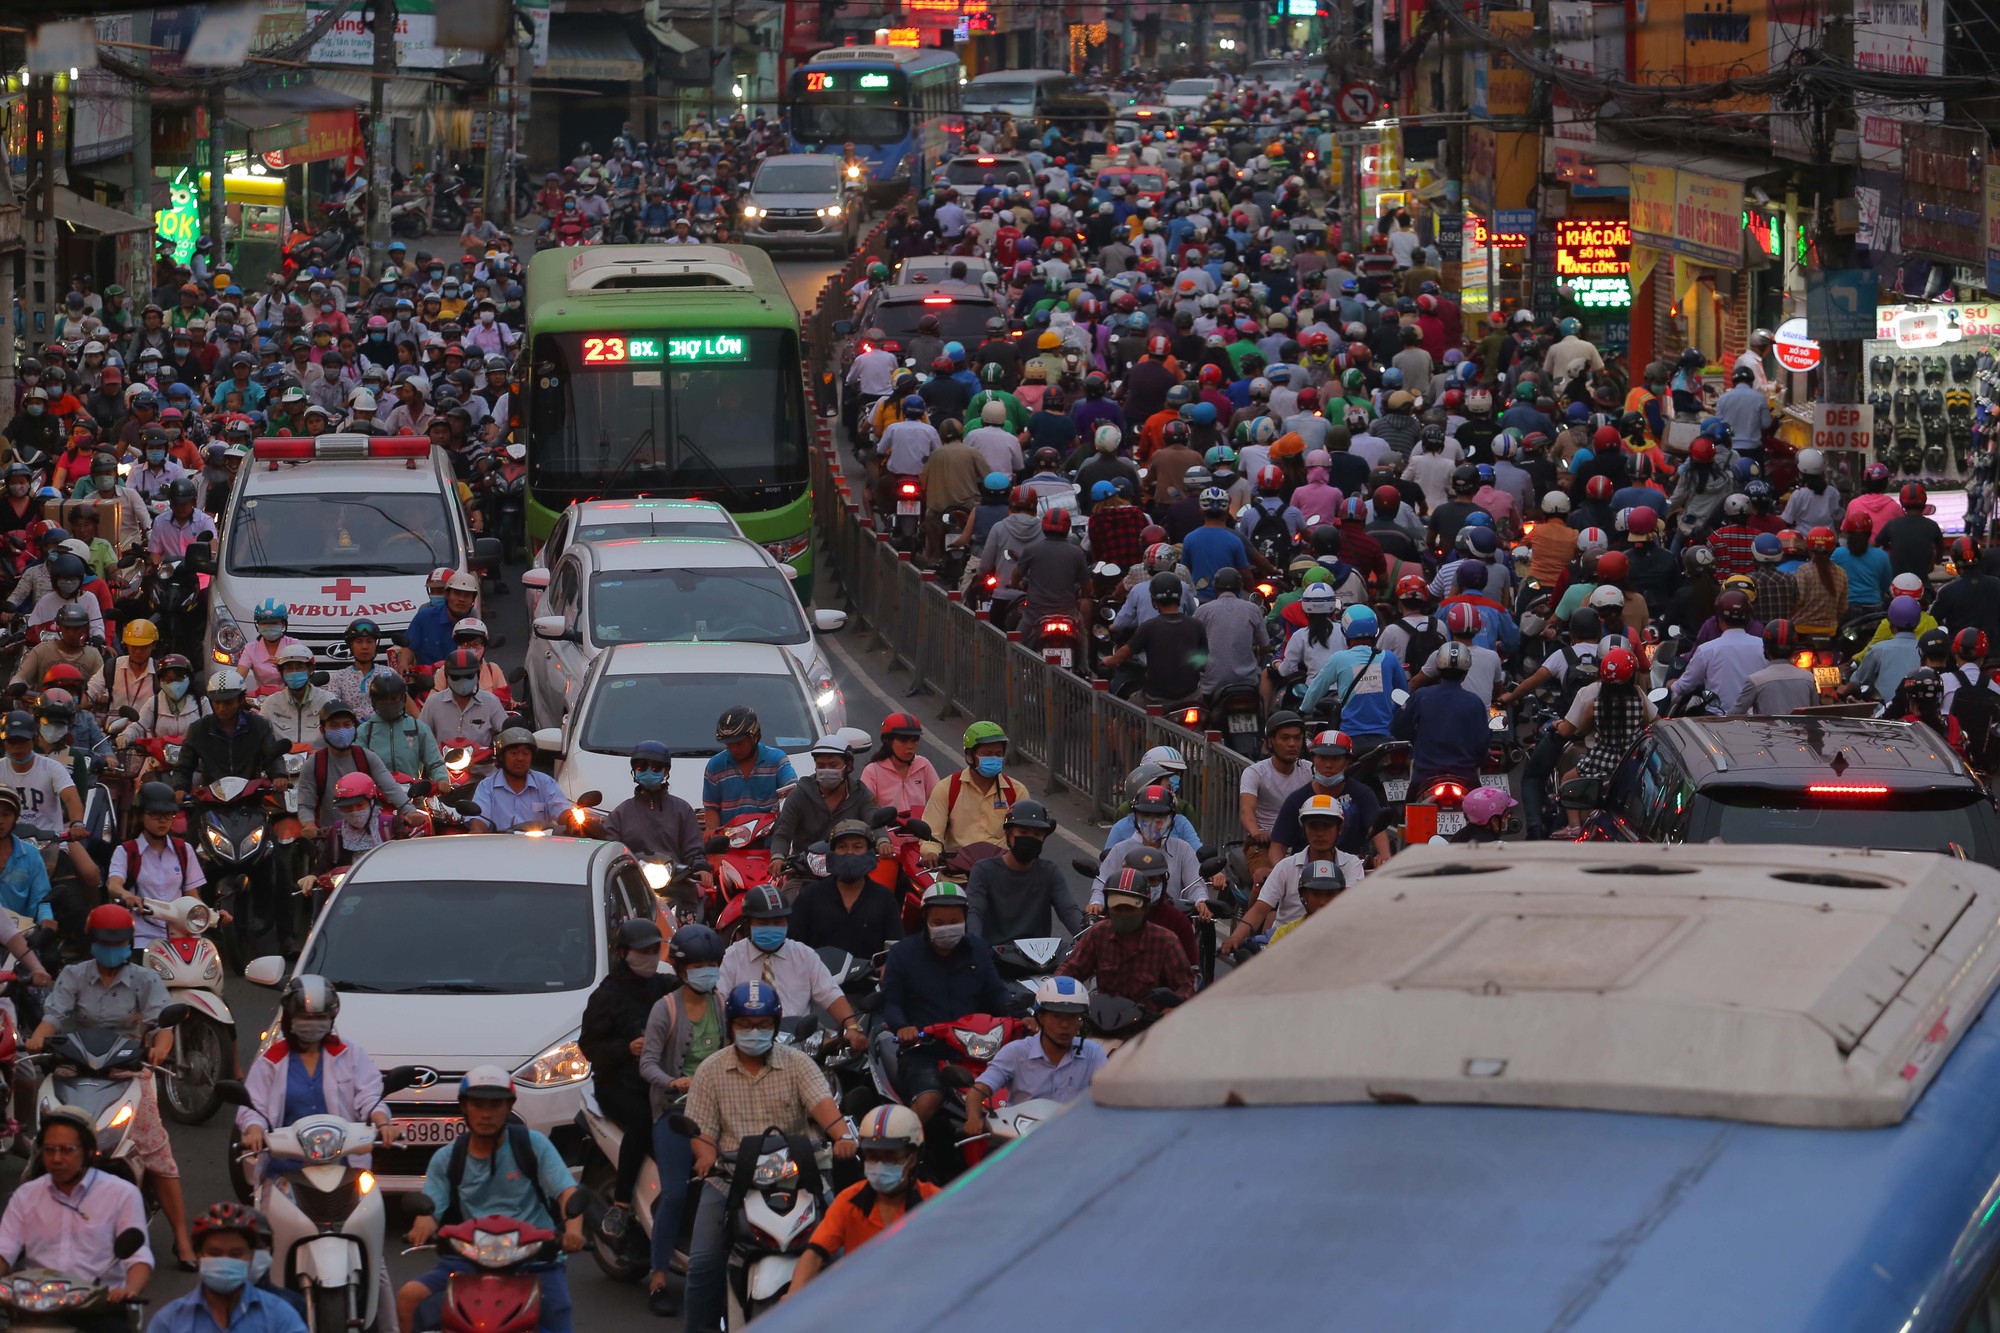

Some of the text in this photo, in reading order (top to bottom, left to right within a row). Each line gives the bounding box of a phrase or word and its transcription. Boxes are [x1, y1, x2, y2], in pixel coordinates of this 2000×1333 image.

[319, 49, 346, 57] Suzuki
[807, 72, 826, 91] 27
[1441, 231, 1462, 242] 592
[1964, 307, 1988, 319] SU
[584, 337, 626, 362] 23
[629, 341, 659, 357] BX.
[705, 335, 742, 355] LỚN
[1825, 405, 1860, 426] DÉP
[1815, 430, 1870, 449] CAO SU
[287, 600, 417, 617] MBULANCE
[16, 786, 44, 812] AP
[1388, 791, 1405, 800] 507
[1438, 823, 1463, 833] 74.87
